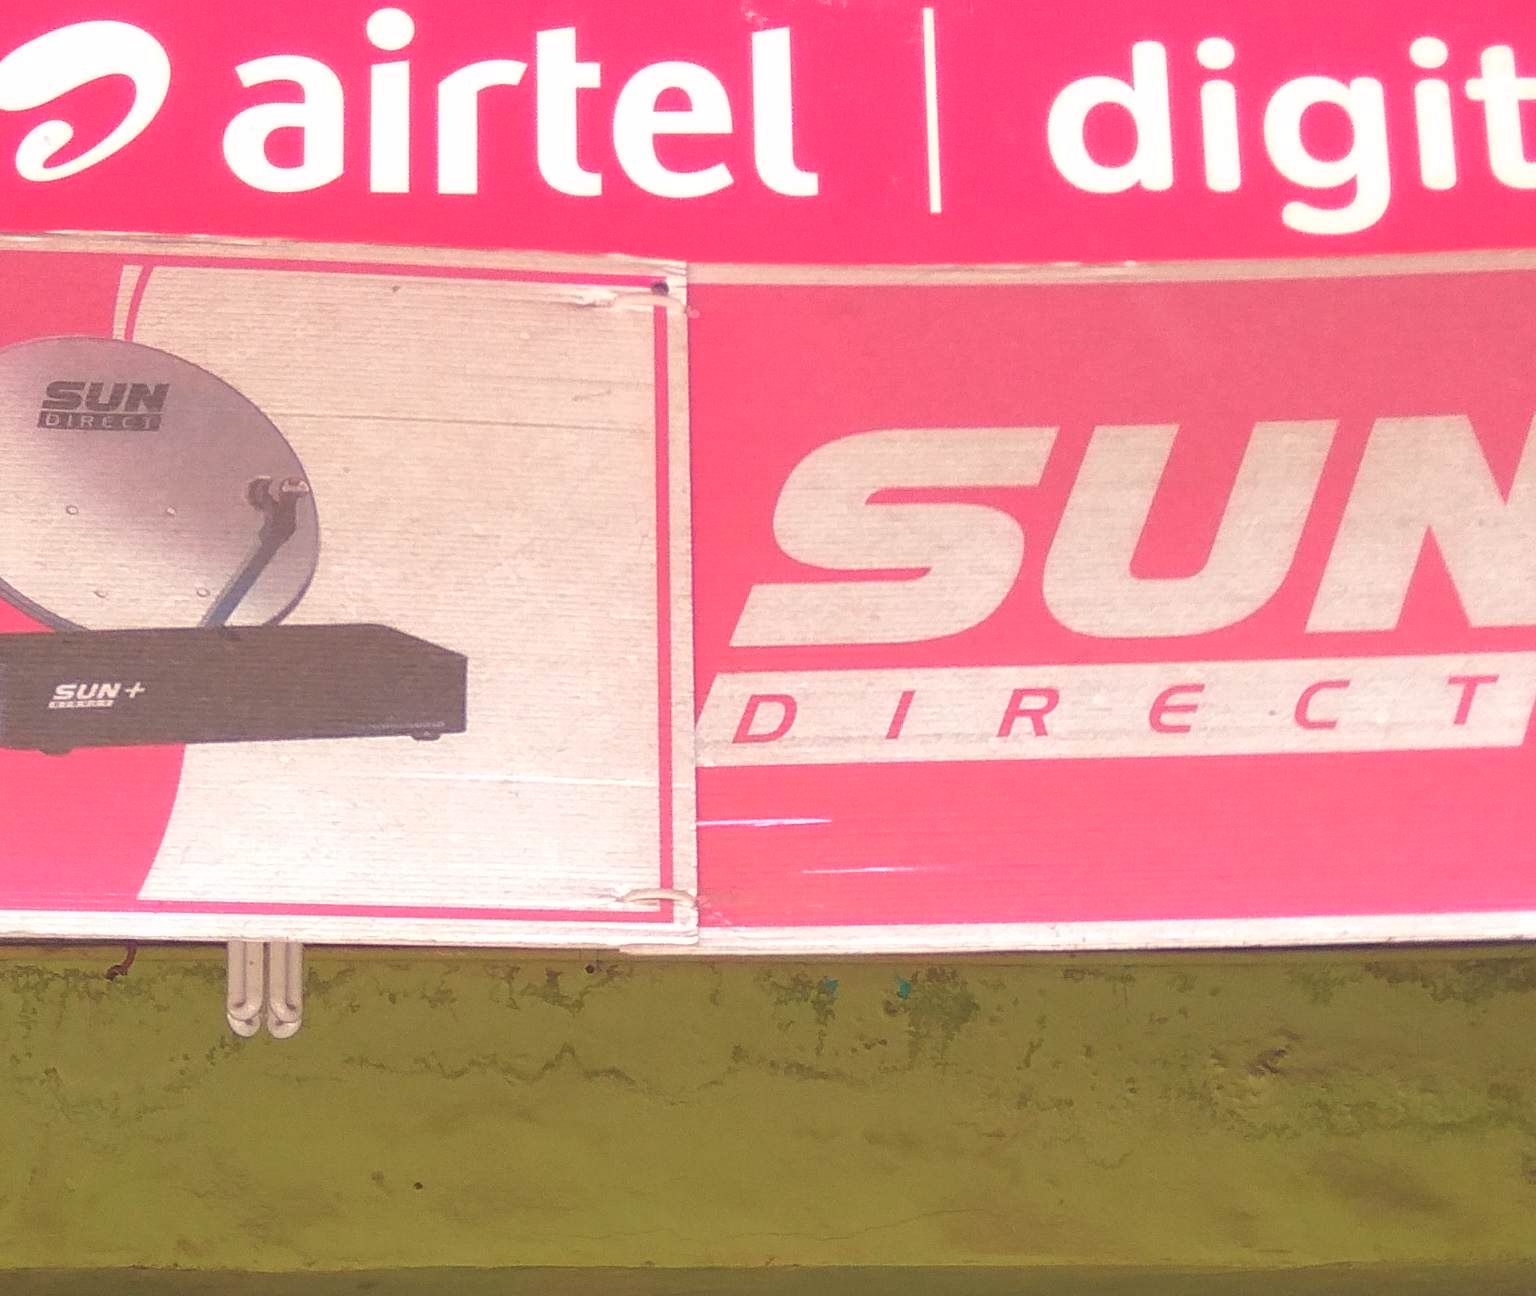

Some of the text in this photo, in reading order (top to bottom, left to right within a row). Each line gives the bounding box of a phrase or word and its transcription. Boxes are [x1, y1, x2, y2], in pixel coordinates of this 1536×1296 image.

[222, 6, 820, 199] airtel
[41, 380, 171, 413] SUN
[44, 412, 154, 430] DIRECT
[731, 674, 1499, 746] DIRECT
